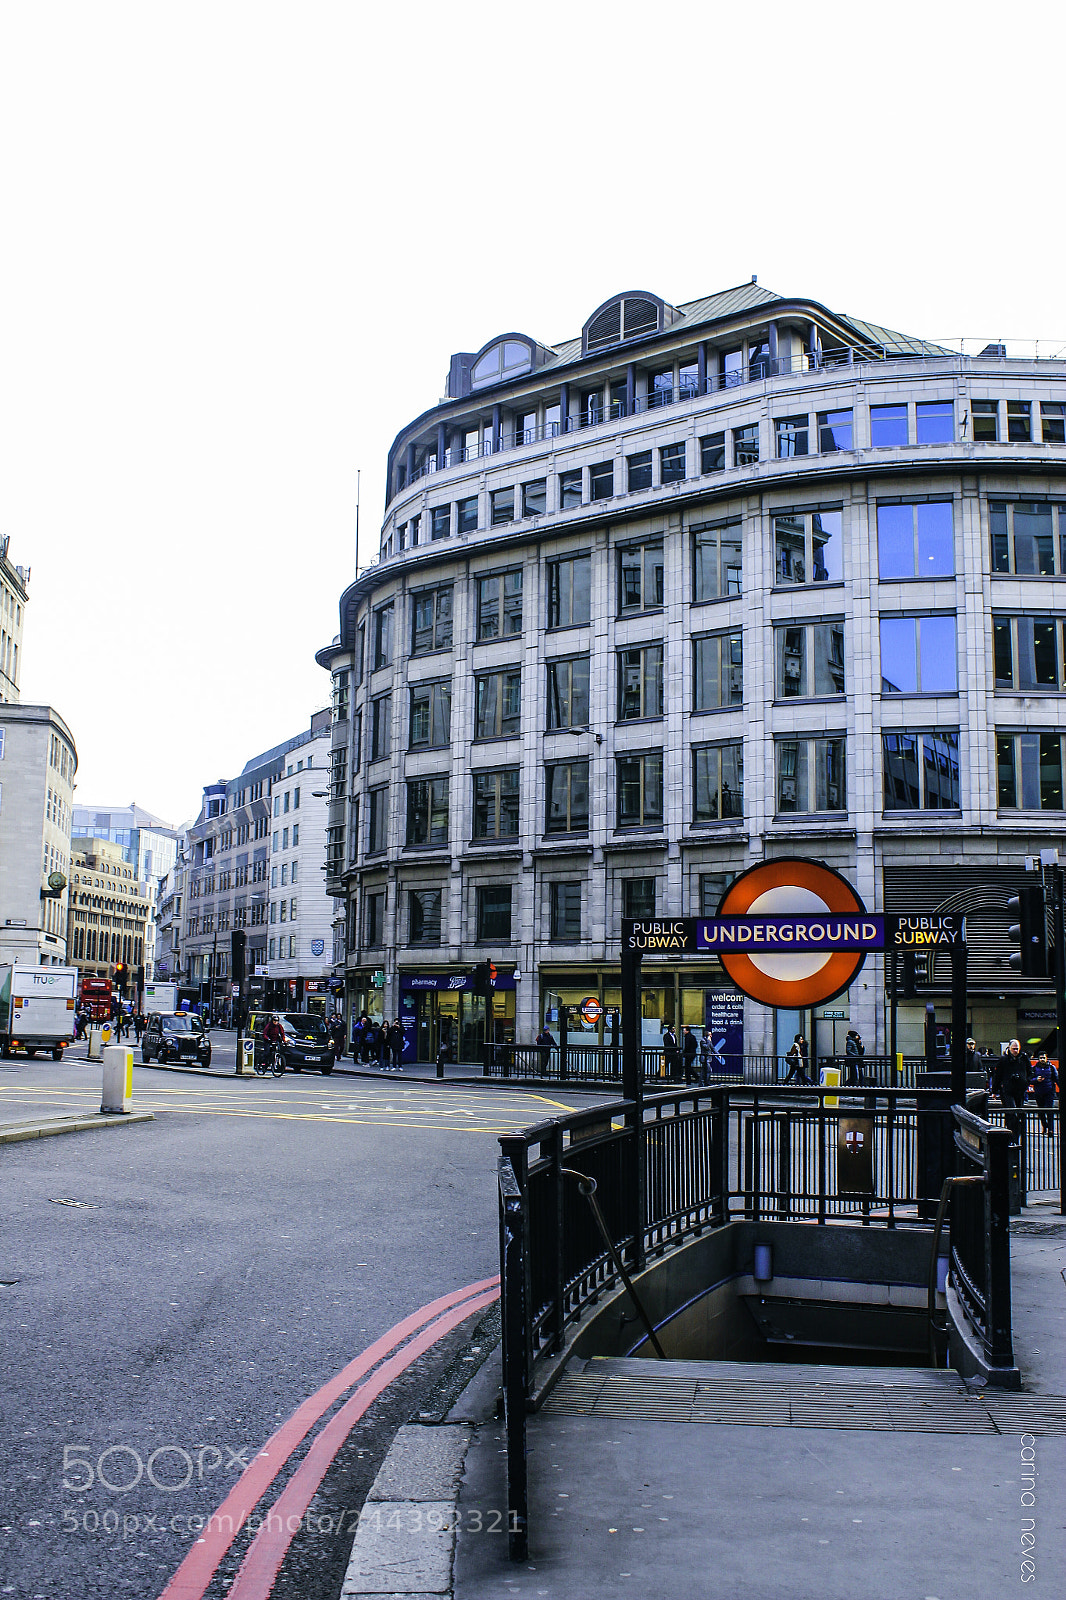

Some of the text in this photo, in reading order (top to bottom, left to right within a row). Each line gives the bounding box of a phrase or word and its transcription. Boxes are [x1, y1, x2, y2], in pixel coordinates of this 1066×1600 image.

[632, 922, 684, 935] PUBLIC
[898, 917, 953, 930] PUBLIC
[703, 923, 877, 943] UNDERGROUND
[893, 930, 958, 944] SUBWAY
[628, 935, 688, 949] SUBWAY
[411, 978, 438, 986] pharmacy
[711, 993, 743, 1002] welcom
